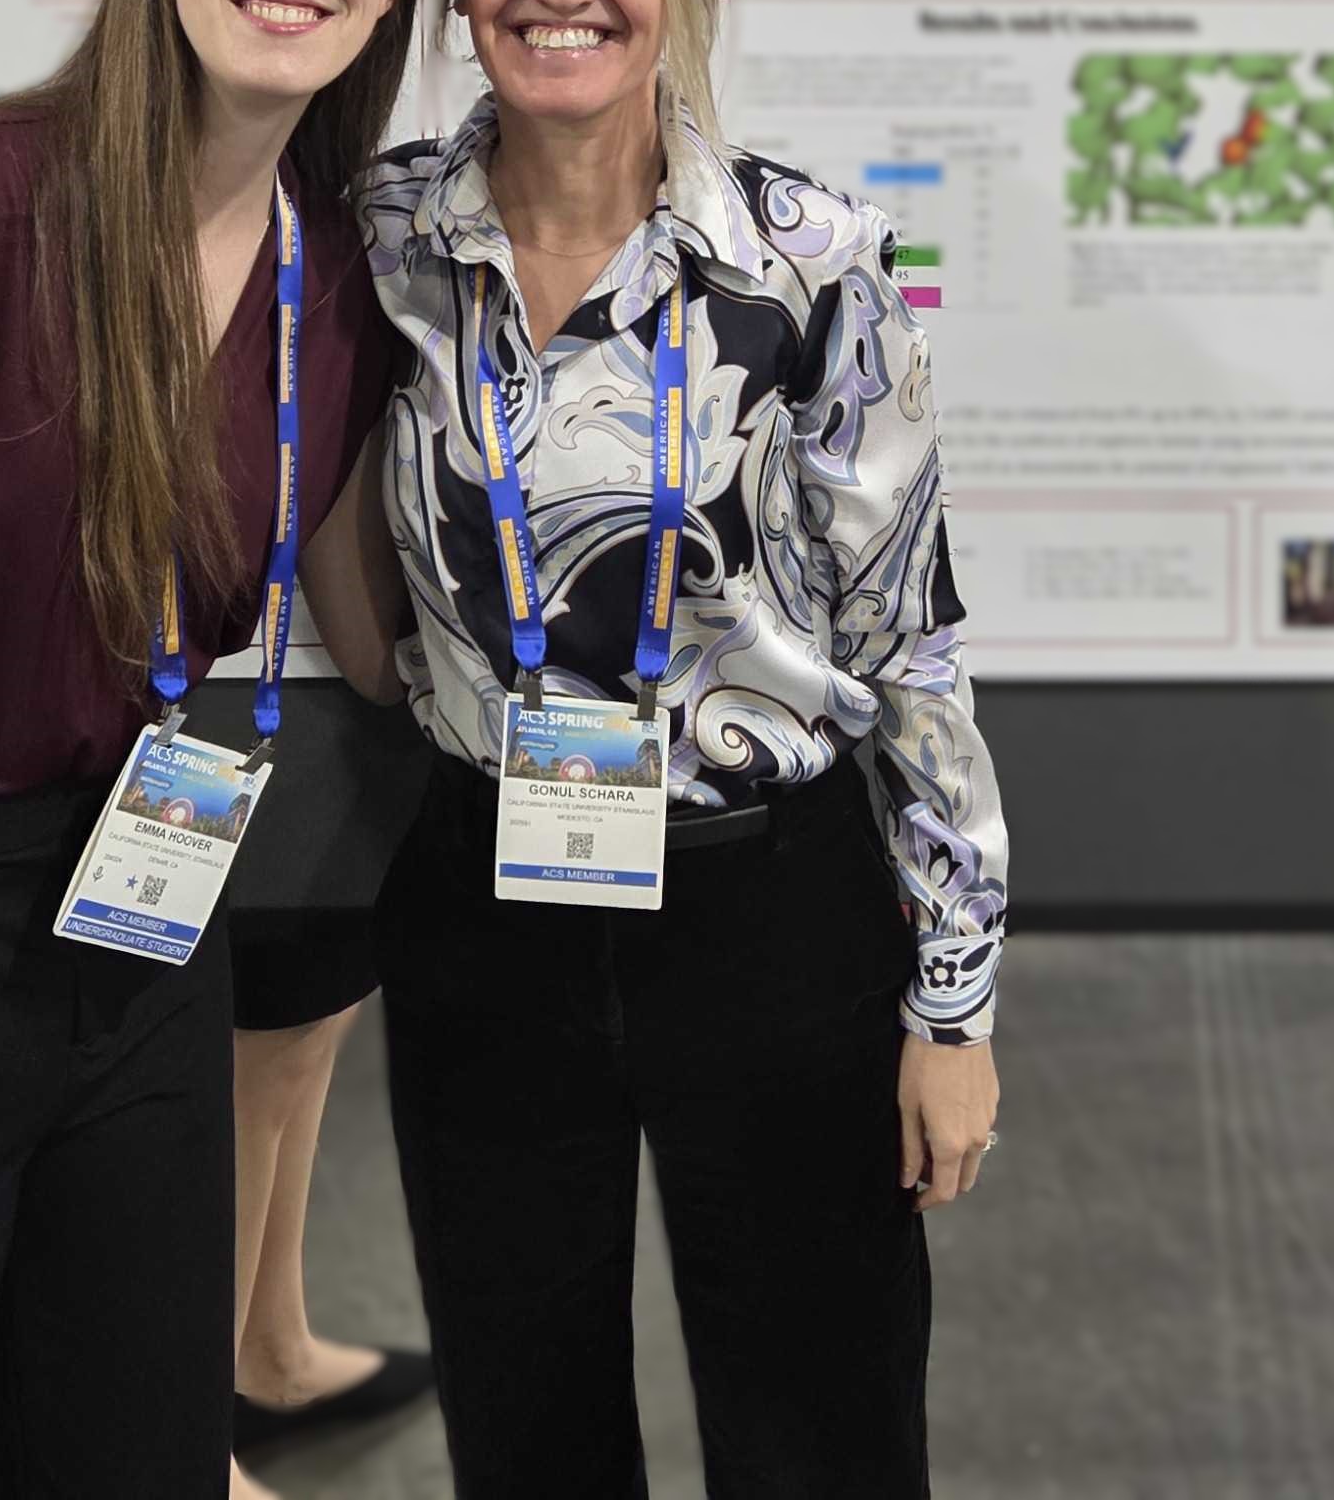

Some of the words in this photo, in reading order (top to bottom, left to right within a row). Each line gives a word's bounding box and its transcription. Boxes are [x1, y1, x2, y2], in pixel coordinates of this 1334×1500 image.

[896, 271, 909, 281] 95
[492, 395, 510, 467] AMERICAN
[659, 399, 668, 476] AMERICAN
[285, 456, 296, 532] AMERICAN
[515, 528, 535, 606] AMERICAN
[647, 541, 661, 616] AMERICAN
[272, 595, 287, 671] AMERICAN
[518, 709, 546, 725] ACS
[548, 712, 605, 729] SPRING
[147, 743, 173, 762] ACS
[172, 750, 218, 776] SPRING
[507, 798, 548, 808] CALIFORNIA
[549, 801, 570, 810] STATE
[571, 803, 612, 813] UNIVERSITY
[529, 784, 575, 798] GONUL
[579, 787, 635, 802] SCHARA
[134, 821, 166, 840] EMMA
[169, 830, 213, 853] HOOVER
[542, 868, 565, 879] ACS
[567, 869, 616, 882] MEMBER
[107, 910, 127, 923] ACS
[127, 915, 168, 933] MEMBER
[65, 919, 147, 948] UNDERGRADUATE
[146, 940, 189, 958] STUDENT
